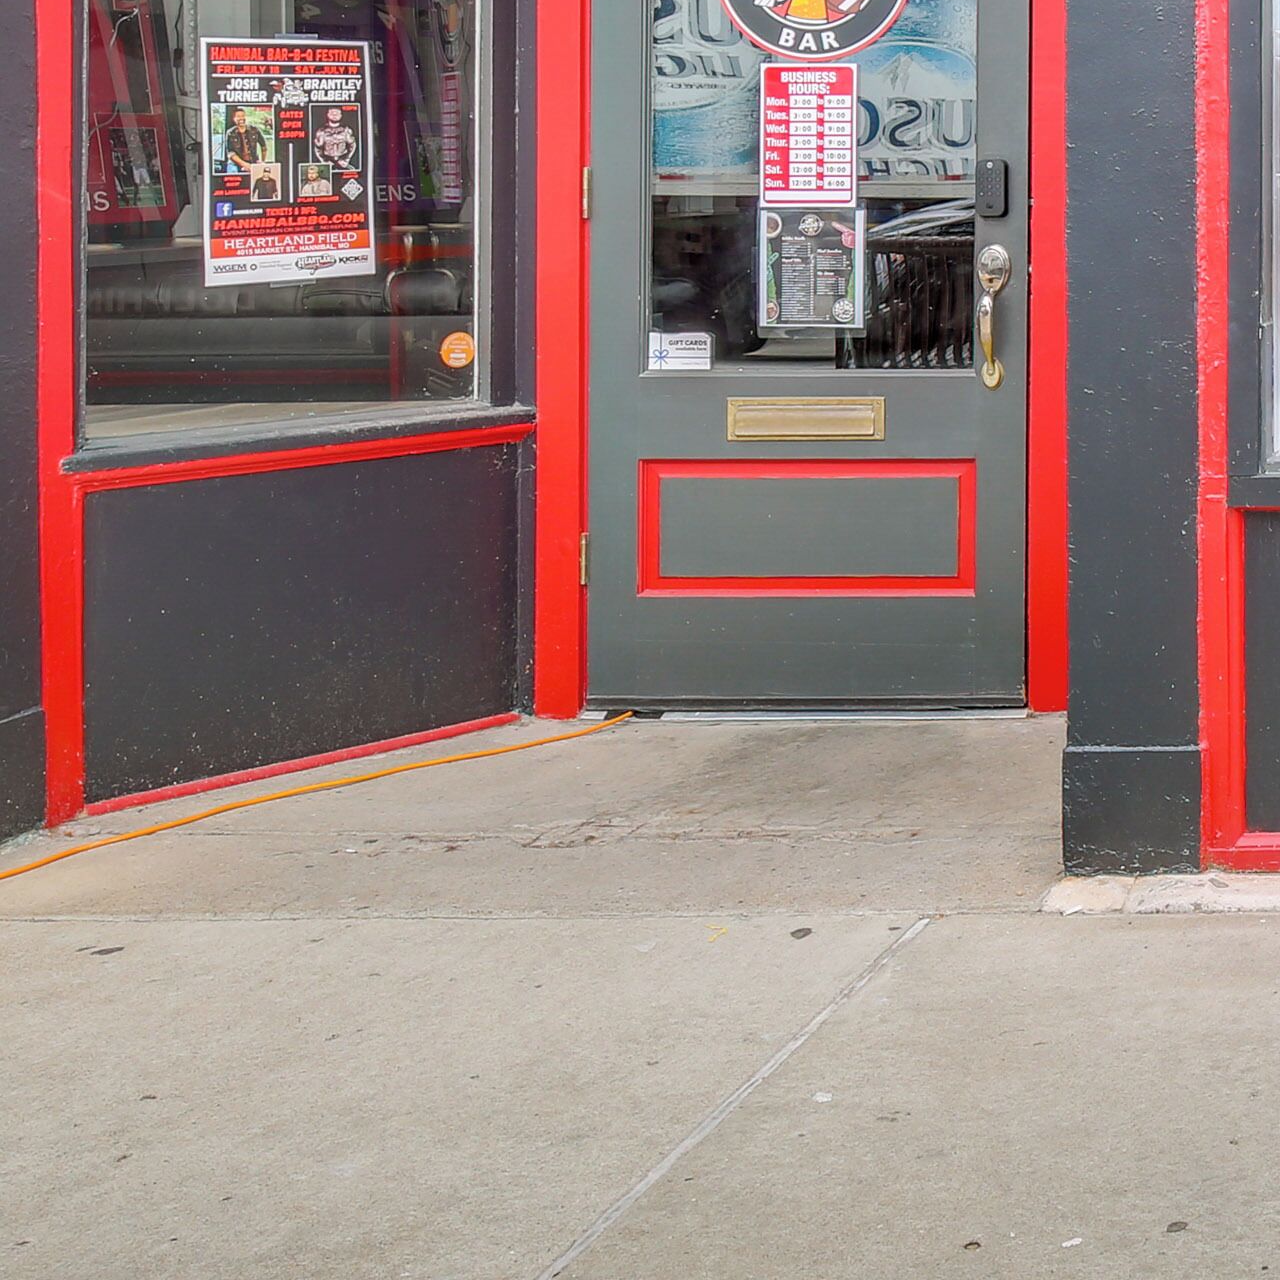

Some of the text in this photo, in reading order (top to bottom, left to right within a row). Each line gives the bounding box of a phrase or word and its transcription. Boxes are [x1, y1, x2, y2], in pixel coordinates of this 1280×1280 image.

[778, 28, 841, 52] BAR
[210, 47, 361, 62] HANNIBAL BAR-B-Q FESTIVAL
[781, 71, 836, 82] BUSINESS
[226, 78, 363, 90] JOSH BRANTLEY
[788, 83, 830, 94] HOURS:
[218, 90, 357, 102] TURNER GILBERT
[766, 97, 788, 106] Mon.
[279, 110, 304, 119] GATES
[766, 111, 788, 120] Tues.
[282, 121, 302, 129] OPEN
[766, 124, 788, 133] Wed.
[766, 138, 788, 147] Thur.
[765, 151, 780, 160] Fri.
[765, 165, 782, 174] Sat.
[765, 178, 785, 188] Sun.
[213, 213, 365, 230] HANNIBALBBQ.COM
[224, 232, 357, 249] HEARTLAND FIELD
[254, 246, 285, 255] MARKET
